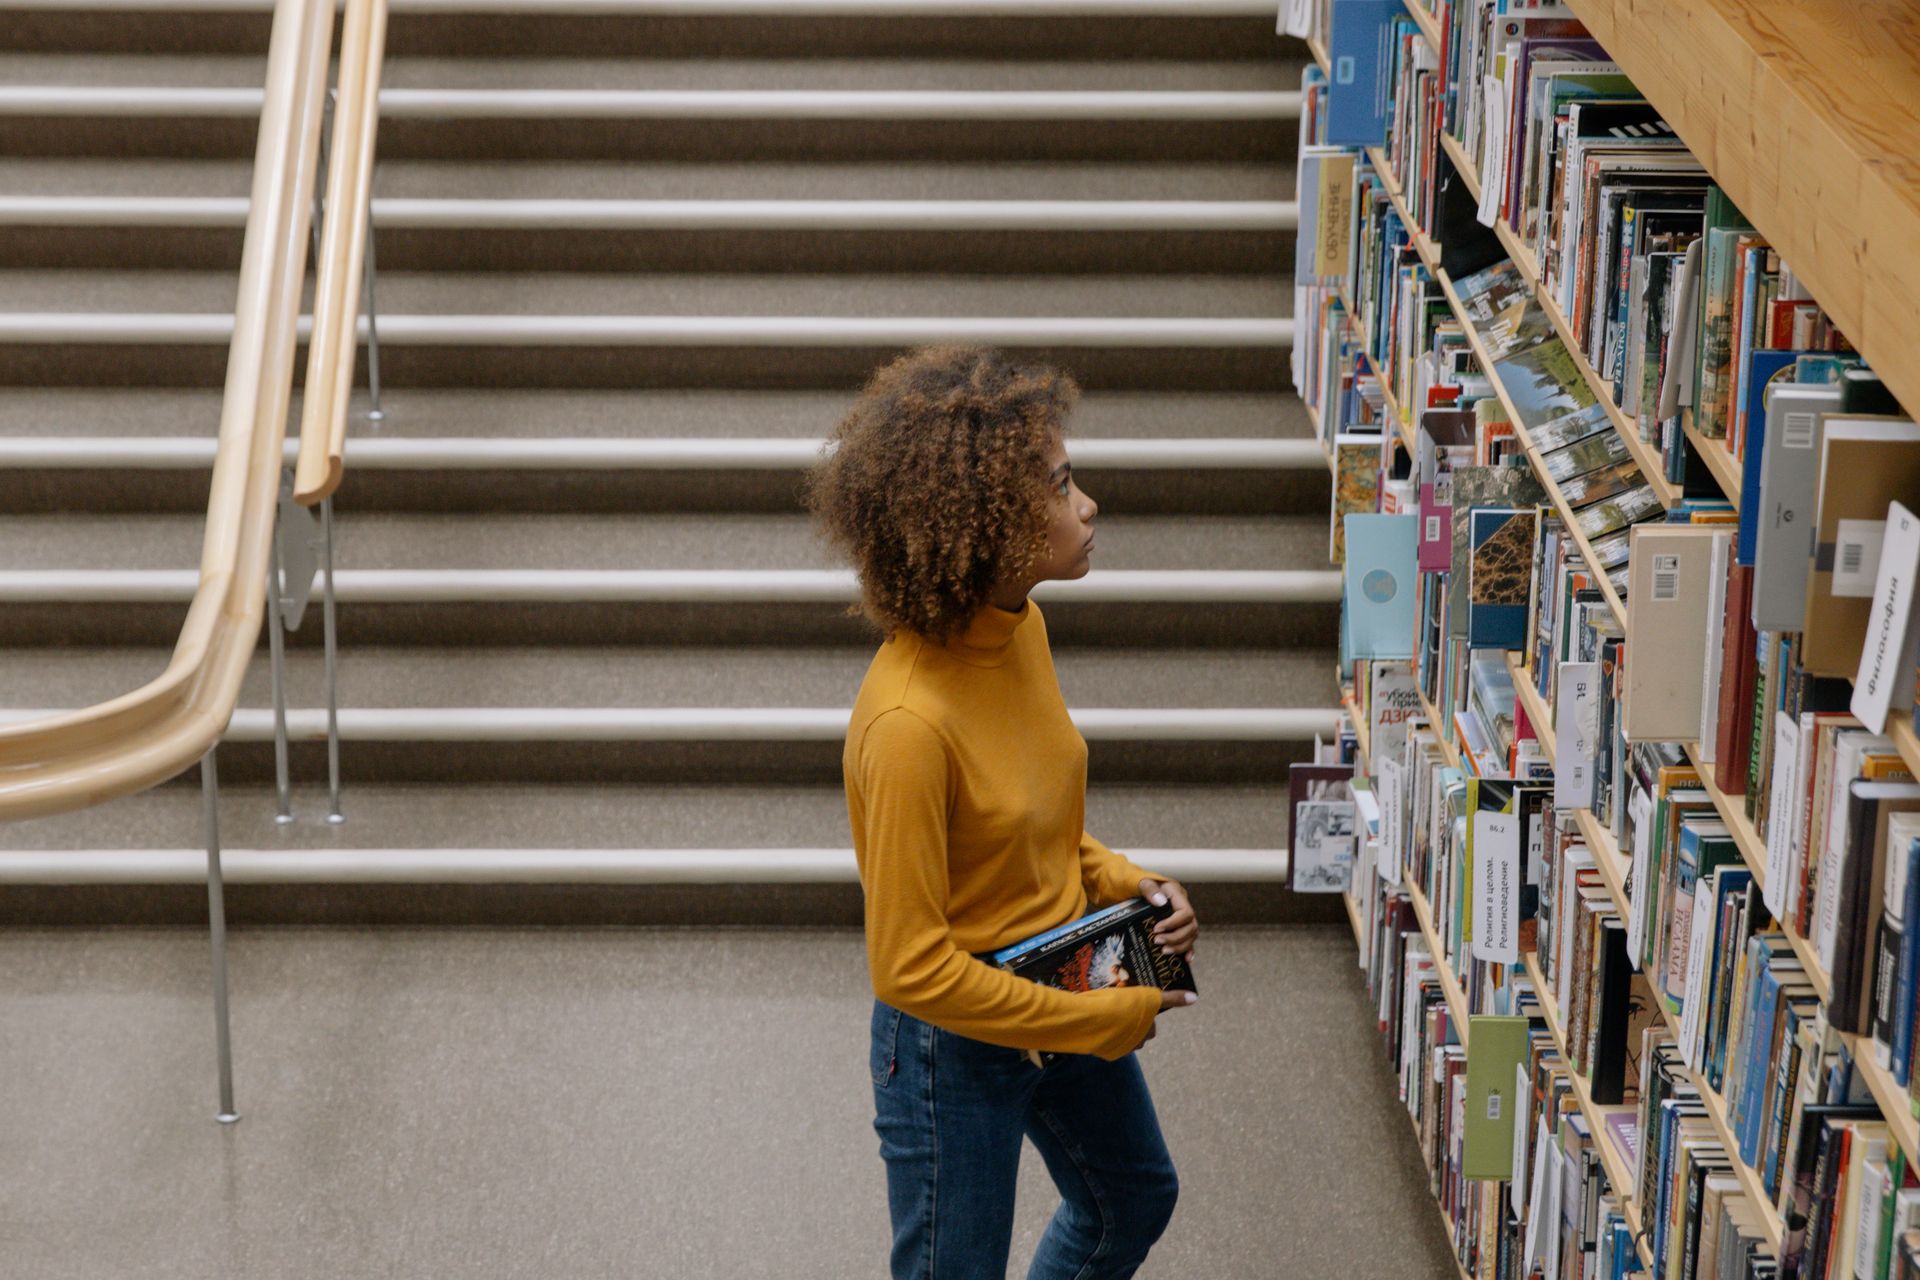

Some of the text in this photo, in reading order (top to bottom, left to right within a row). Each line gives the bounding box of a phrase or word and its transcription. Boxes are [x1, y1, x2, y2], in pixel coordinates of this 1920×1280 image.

[1326, 181, 1340, 260] ОБУЧЕНИЕ
[1868, 576, 1899, 697] Философия
[1486, 857, 1495, 894] целом.
[1499, 860, 1509, 949] Религиоведение
[1485, 905, 1494, 949] Религия
[1670, 907, 1684, 976] ИСЛАМА
[1804, 1155, 1825, 1250] ТАЙНЫ ЧИСЕЛ
